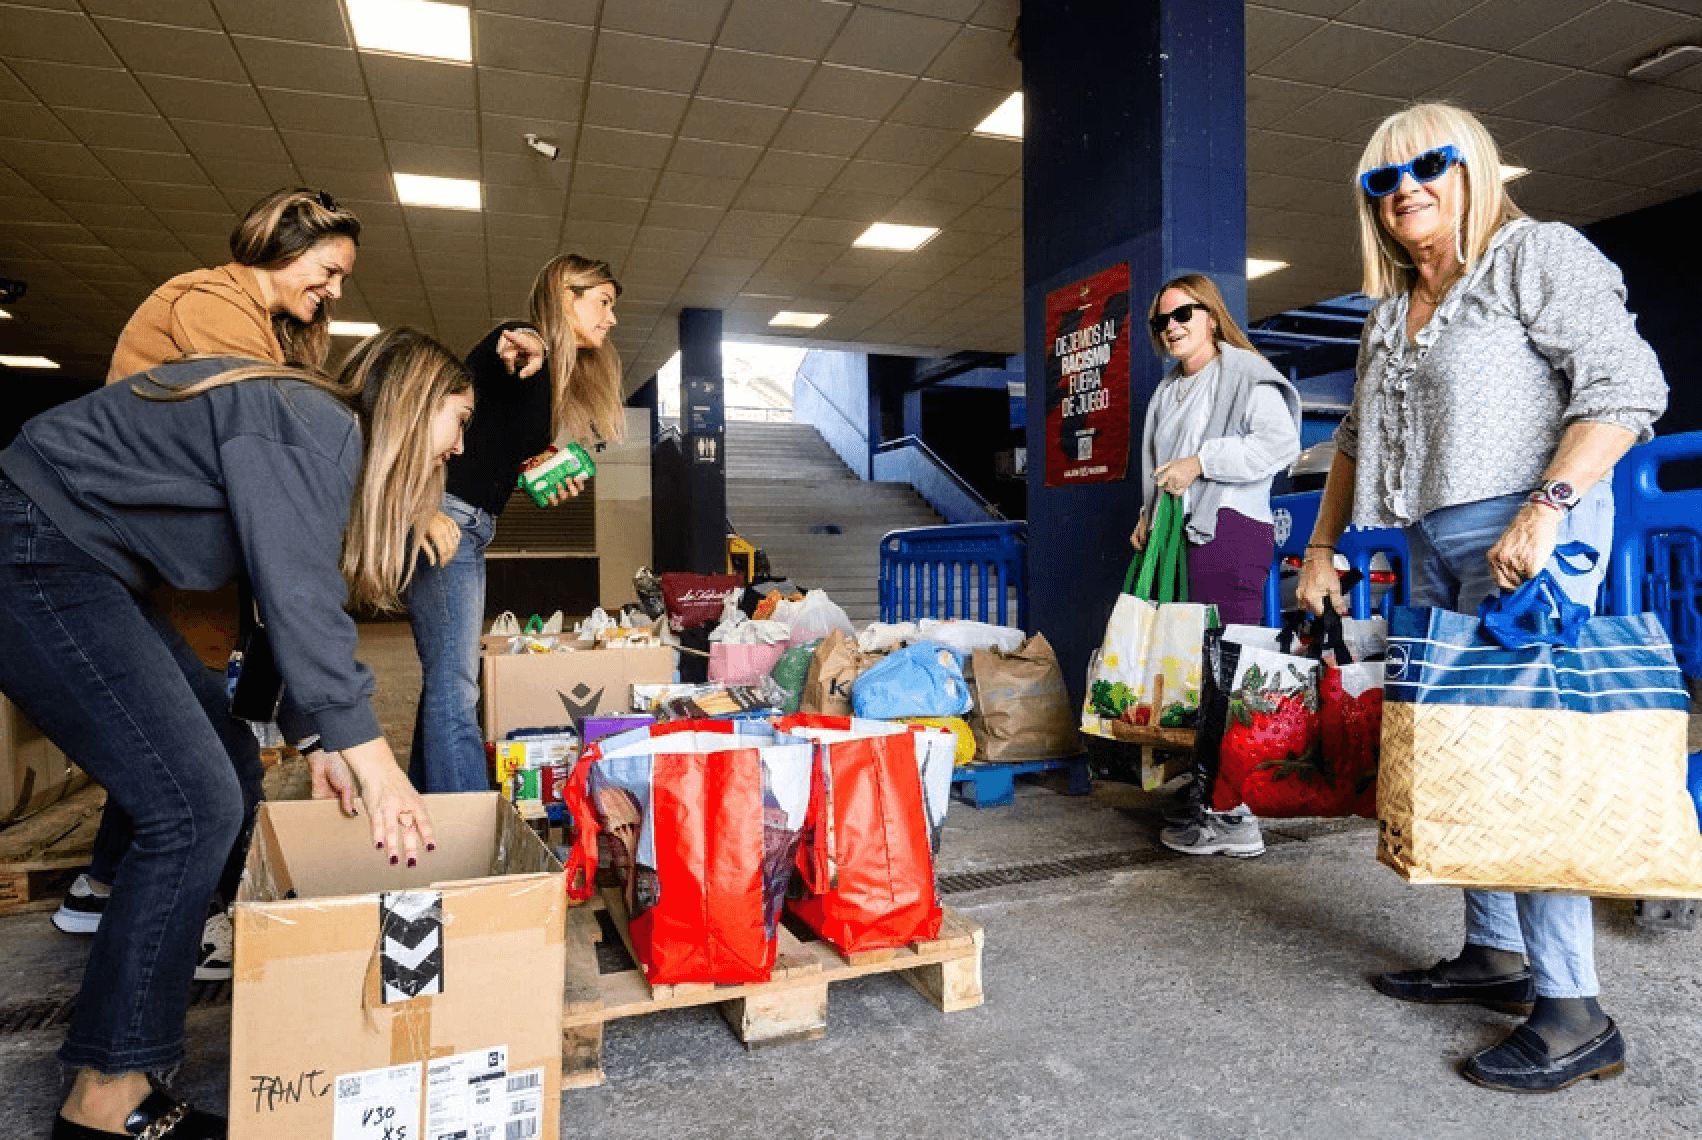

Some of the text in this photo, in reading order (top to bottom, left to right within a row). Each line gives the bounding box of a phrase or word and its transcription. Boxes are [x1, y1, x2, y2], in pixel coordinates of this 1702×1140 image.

[1055, 319, 1117, 357] DEJEMOS AL
[1061, 343, 1110, 376] RACISMO
[1069, 367, 1102, 396] FUERA
[1061, 387, 1109, 418] DE JUEGO
